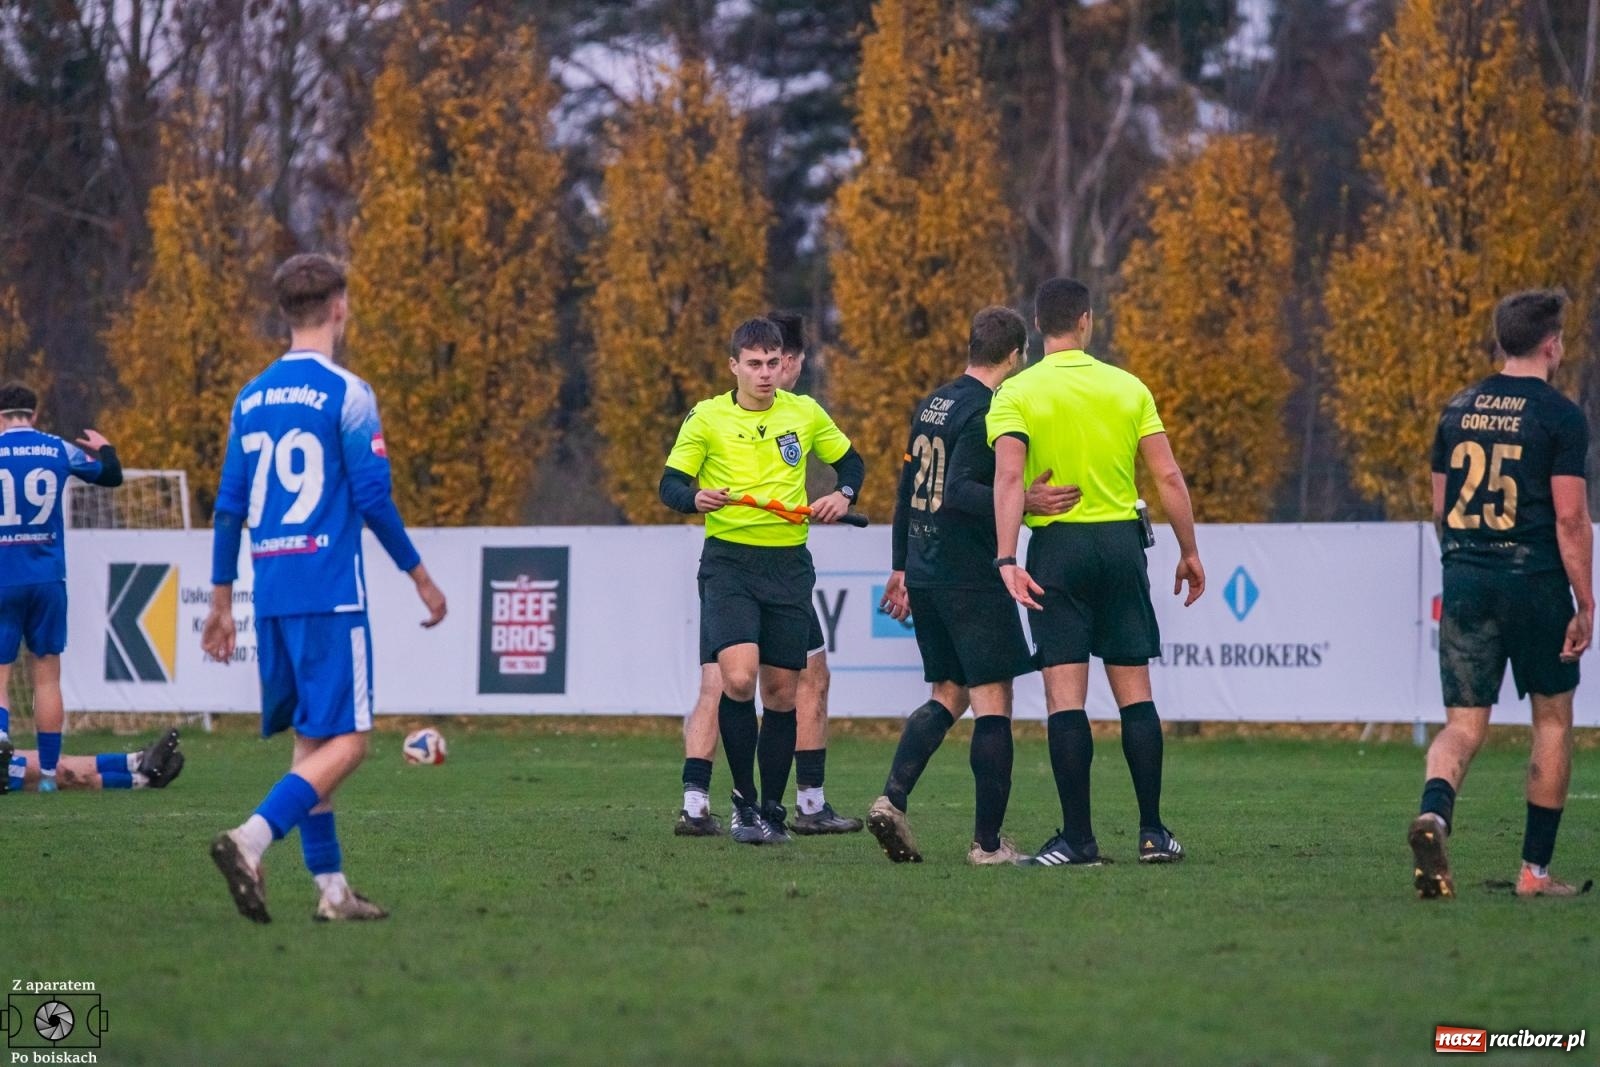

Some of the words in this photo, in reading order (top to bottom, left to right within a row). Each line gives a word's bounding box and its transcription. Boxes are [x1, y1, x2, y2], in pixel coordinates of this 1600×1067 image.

[1474, 394, 1527, 411] CZARNI
[1460, 413, 1521, 432] GORZYCE
[241, 427, 325, 528] 79
[911, 433, 946, 513] 20
[1447, 440, 1523, 531] 25
[0, 467, 57, 526] 19
[492, 591, 557, 622] BEEF
[491, 624, 555, 652] BROS
[1150, 643, 1214, 667] UPRA
